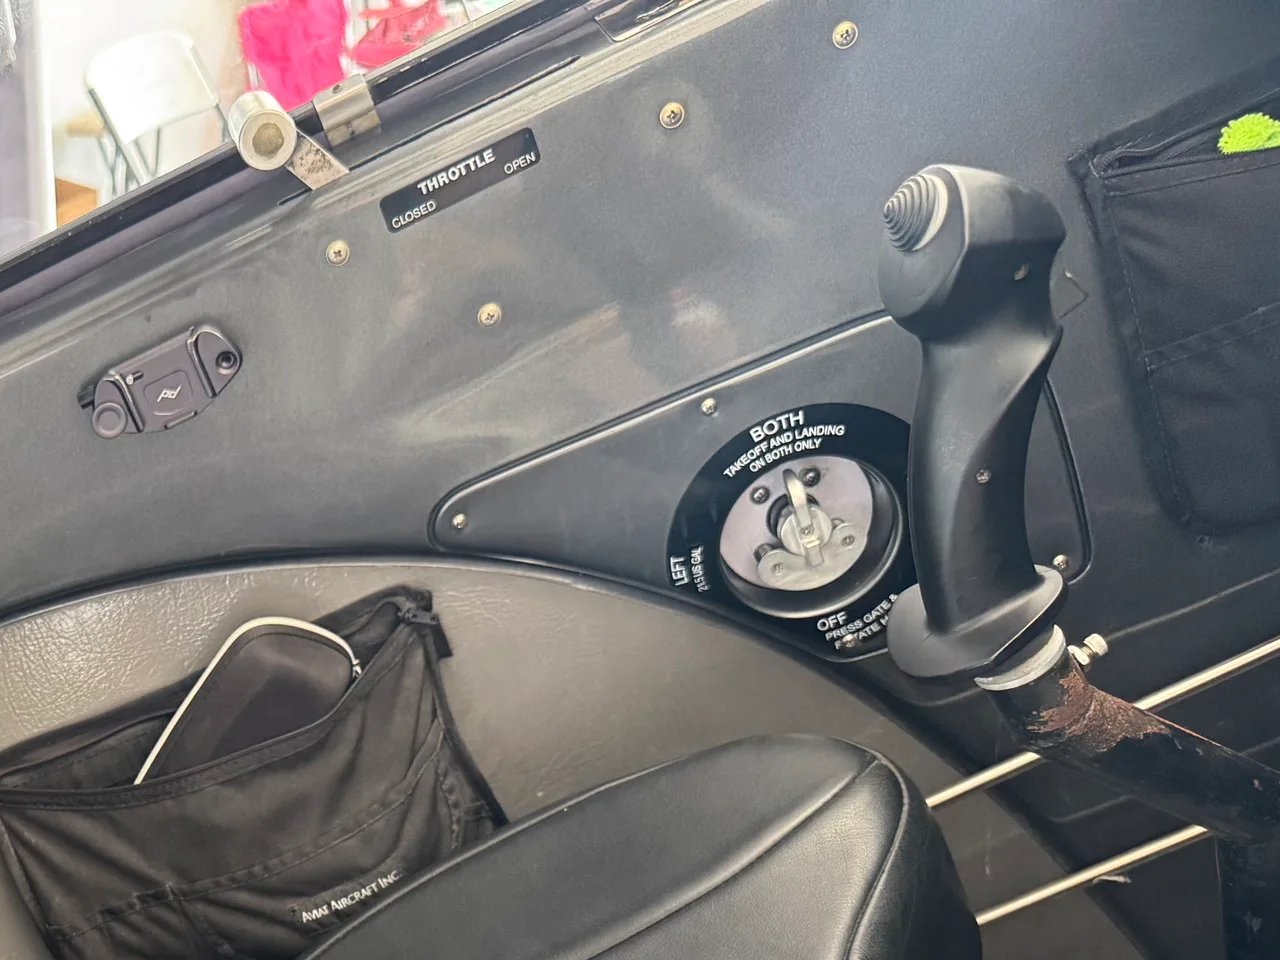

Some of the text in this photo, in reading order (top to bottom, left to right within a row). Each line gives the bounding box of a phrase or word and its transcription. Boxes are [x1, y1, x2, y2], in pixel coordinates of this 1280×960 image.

[391, 151, 536, 229] CLOSED OPEN
[417, 148, 496, 195] THROTTLE
[749, 410, 805, 443] BOTH
[723, 424, 845, 478] TAKEOFF AND LANDING
[749, 438, 823, 472] ON BOTH ONLY
[669, 555, 689, 586] LEFT
[690, 545, 704, 565] GAL
[817, 610, 847, 631] OFF
[825, 619, 864, 641] PRESS
[863, 599, 891, 623] GATE
[302, 904, 329, 923] AVIAT
[330, 882, 379, 911] AIRCRAFT
